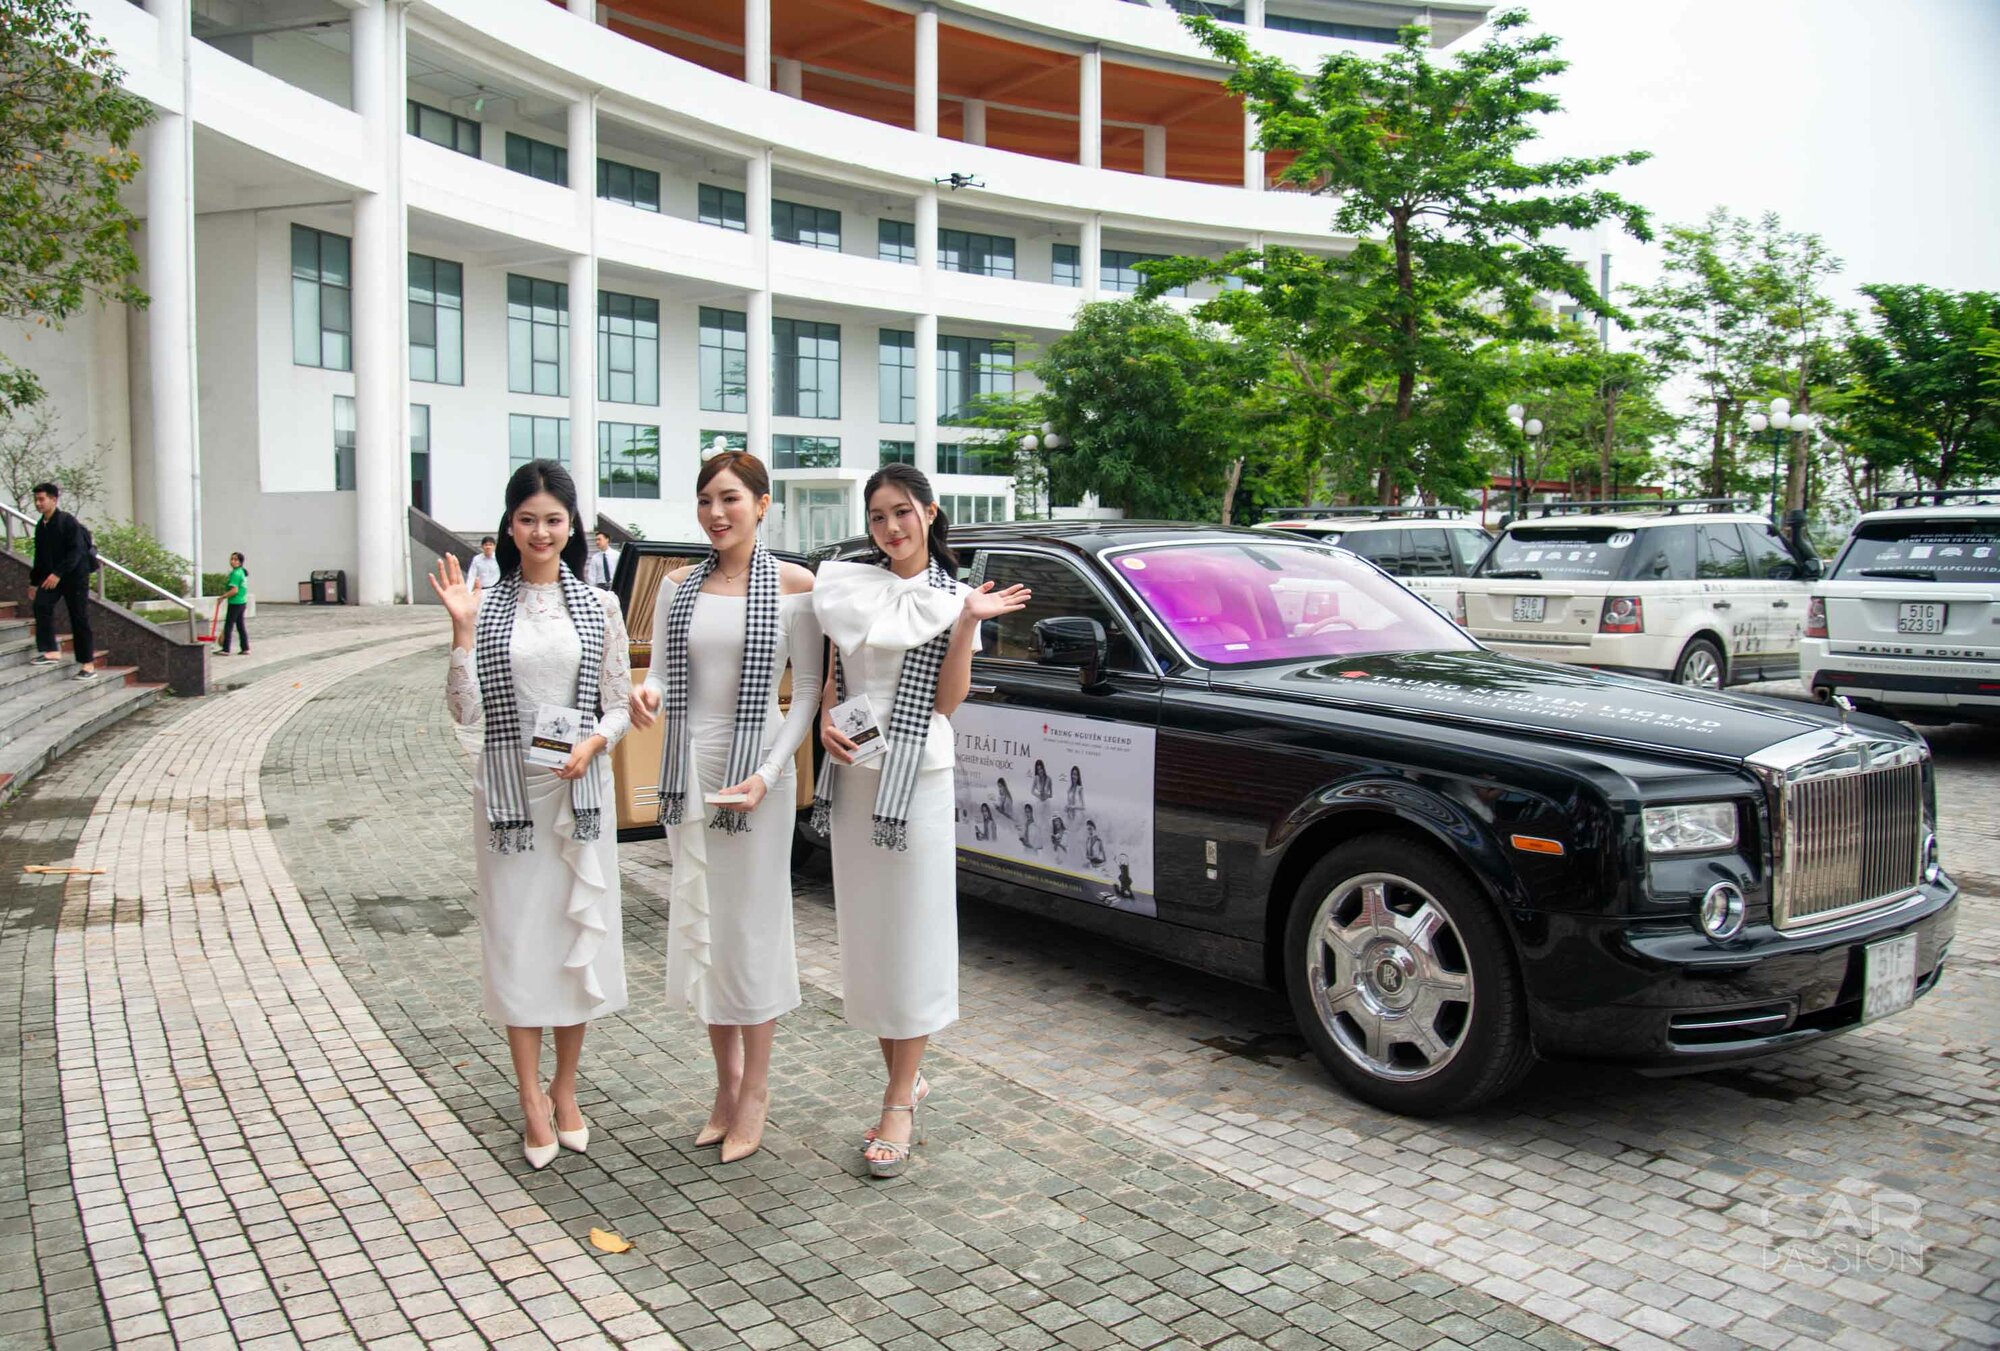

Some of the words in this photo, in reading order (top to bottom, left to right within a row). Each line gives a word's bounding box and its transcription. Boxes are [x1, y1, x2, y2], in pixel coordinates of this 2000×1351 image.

[1613, 534, 1630, 544] 10
[1910, 604, 1935, 618] 51G
[1858, 646, 1914, 654] RANGE
[1925, 649, 1986, 657] ROVER
[1372, 675, 1461, 690] TRUNG
[1600, 705, 1721, 727] LEGEND
[964, 734, 997, 753] TRÁI
[1003, 740, 1031, 758] TIM
[1103, 735, 1133, 745] LEGEND
